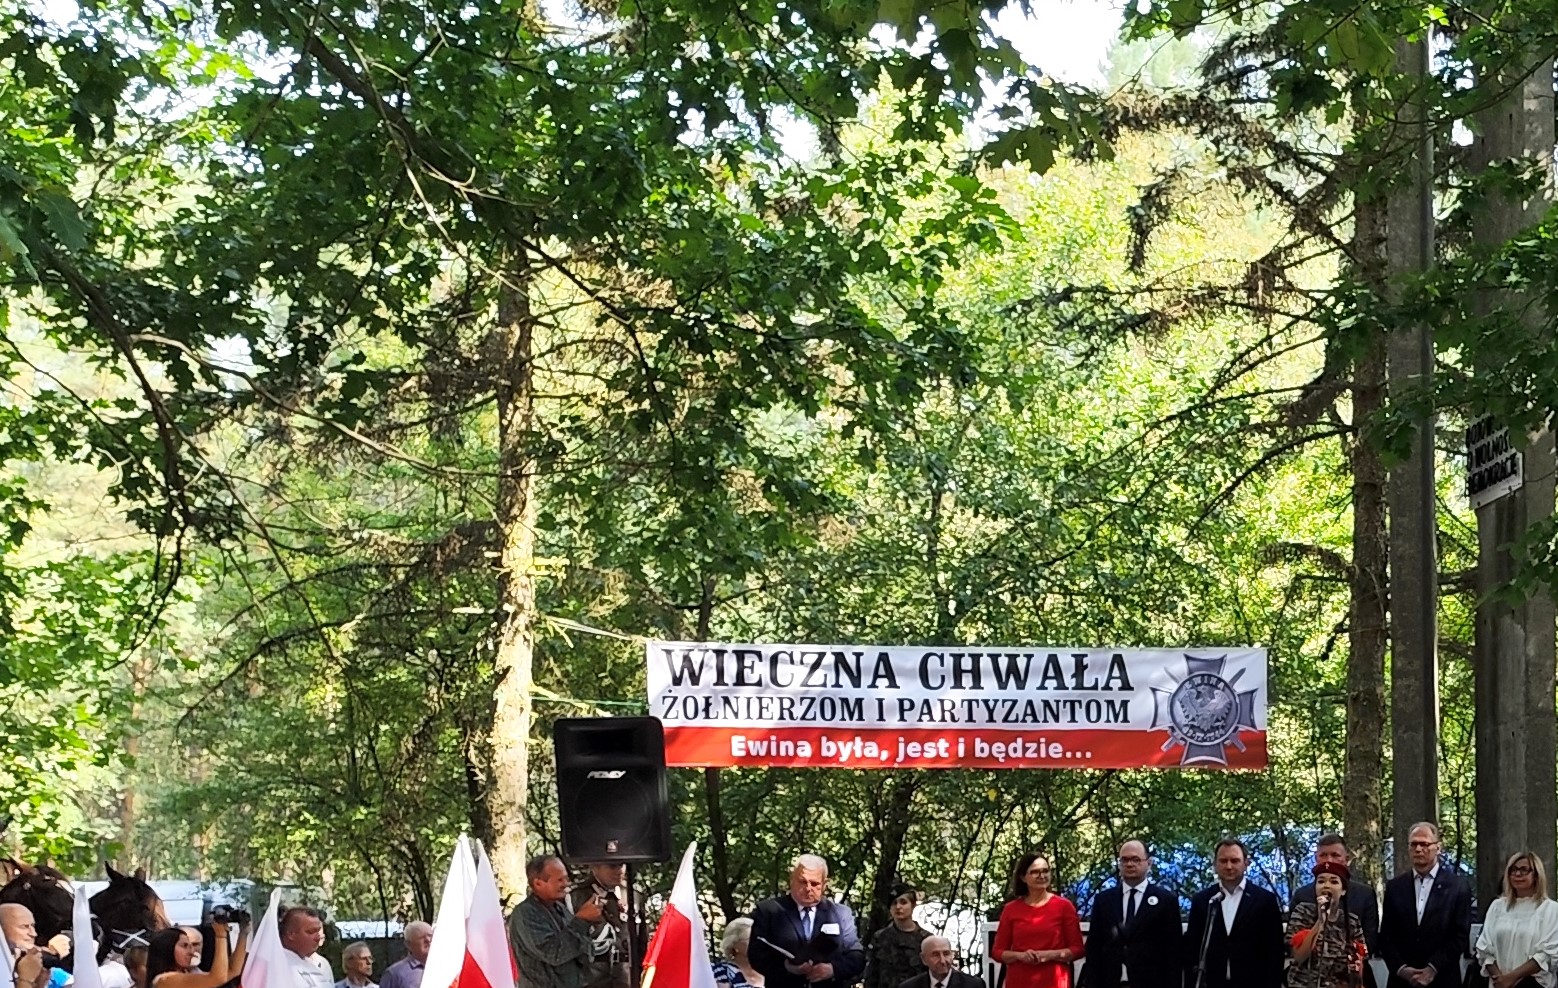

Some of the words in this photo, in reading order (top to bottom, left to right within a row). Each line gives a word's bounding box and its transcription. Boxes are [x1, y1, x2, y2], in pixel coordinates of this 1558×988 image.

[661, 648, 901, 689] WIECZNA
[918, 651, 1135, 691] CHWAŁA
[661, 688, 865, 721] ŻOŁNIERZOM
[876, 698, 887, 722] I
[897, 697, 1131, 724] PARTYZANTOM
[730, 735, 813, 758] Ewina
[820, 736, 889, 762] była,
[896, 737, 950, 763] jest
[957, 737, 966, 758] i
[974, 738, 1093, 763] będzie...
